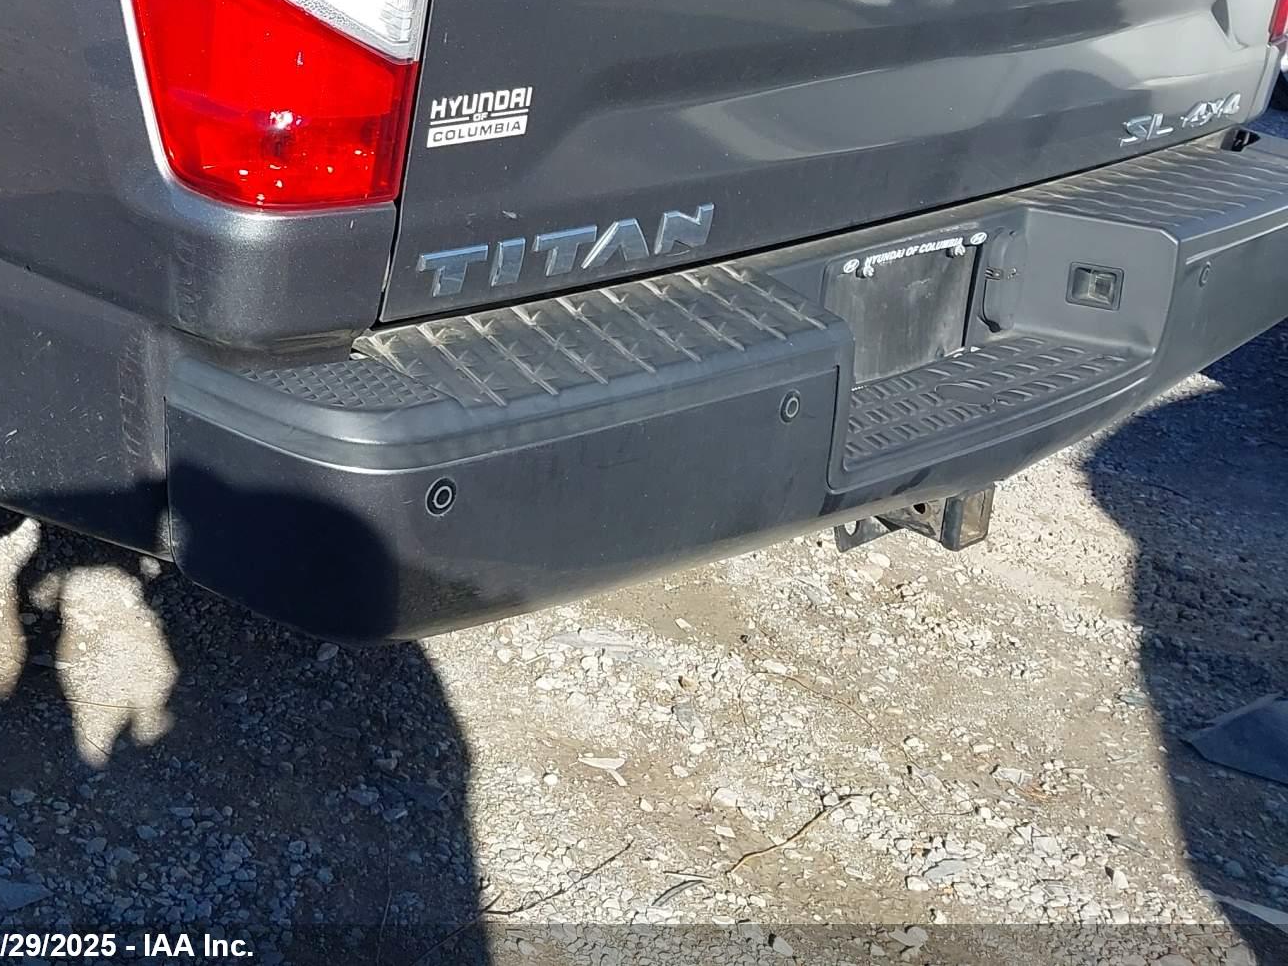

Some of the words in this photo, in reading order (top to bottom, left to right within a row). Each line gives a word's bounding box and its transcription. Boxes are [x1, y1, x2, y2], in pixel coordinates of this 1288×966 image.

[430, 87, 533, 119] HYUNDAI
[473, 111, 489, 122] OF
[432, 121, 522, 143] COLUMBIA
[1119, 113, 1174, 147] SL
[416, 202, 715, 298] TITAN
[864, 248, 905, 266] HYUNDAI
[906, 246, 918, 257] OF
[919, 237, 964, 254] COLUMBIA
